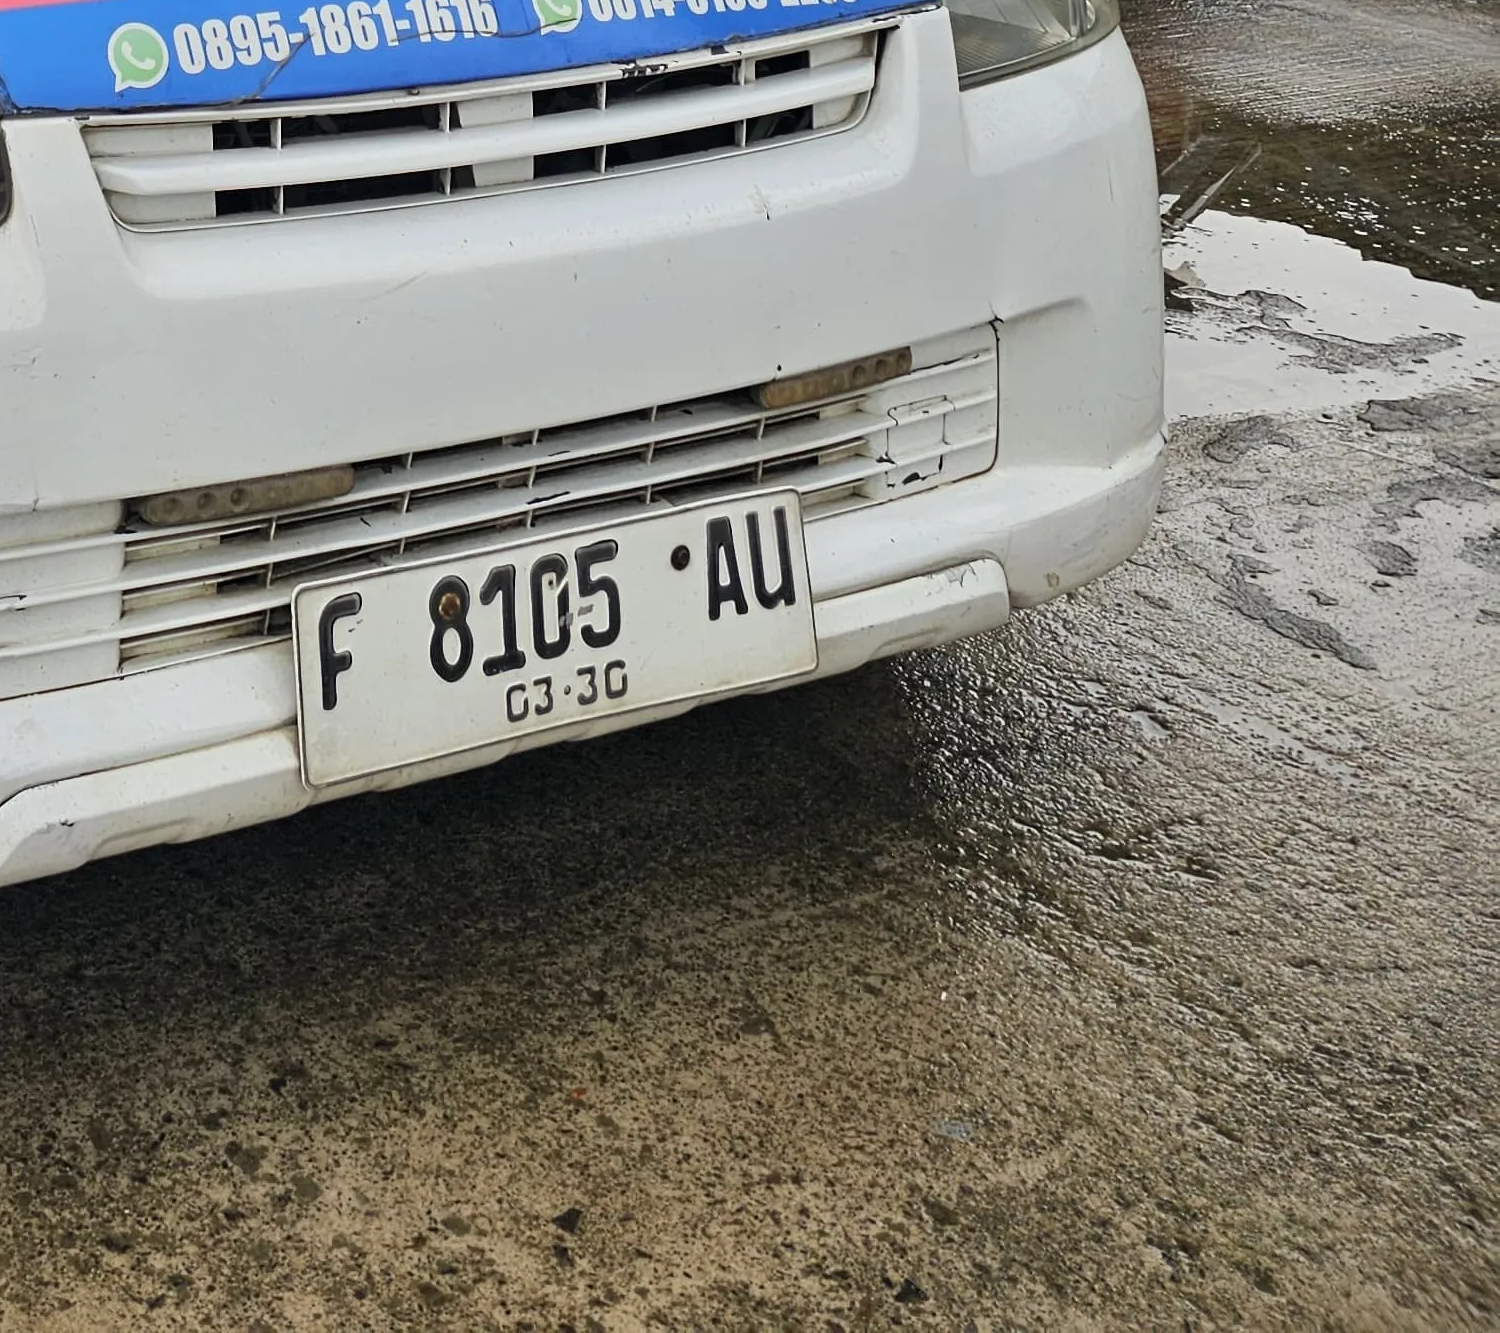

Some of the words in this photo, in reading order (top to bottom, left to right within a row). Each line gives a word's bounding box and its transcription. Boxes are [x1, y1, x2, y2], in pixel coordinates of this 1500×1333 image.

[318, 591, 363, 711] F
[429, 539, 622, 683] 8105
[706, 507, 796, 620] AU
